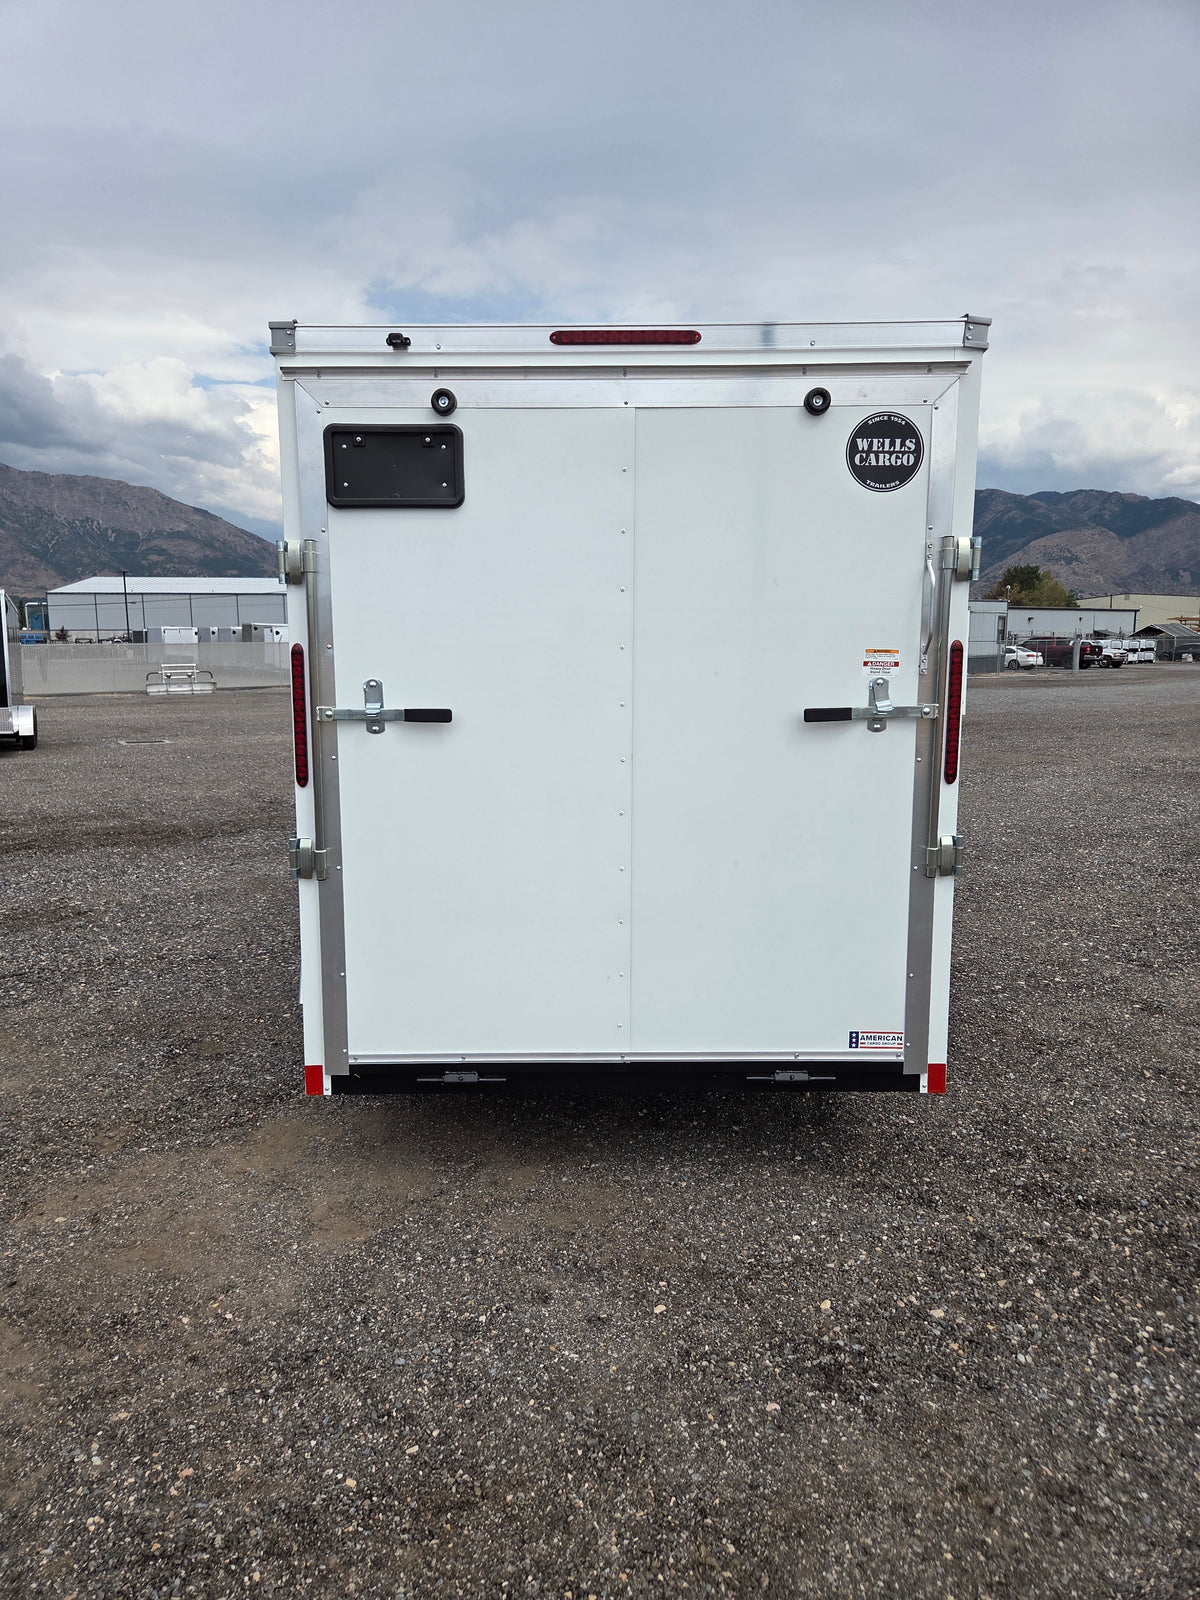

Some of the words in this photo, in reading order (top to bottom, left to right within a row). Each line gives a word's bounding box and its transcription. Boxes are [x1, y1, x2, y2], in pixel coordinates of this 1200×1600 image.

[867, 415, 889, 425] SINCE
[890, 416, 906, 425] 1954
[856, 438, 916, 452] WELLS
[854, 453, 915, 466] CARGO
[866, 479, 900, 488] TRAILERS
